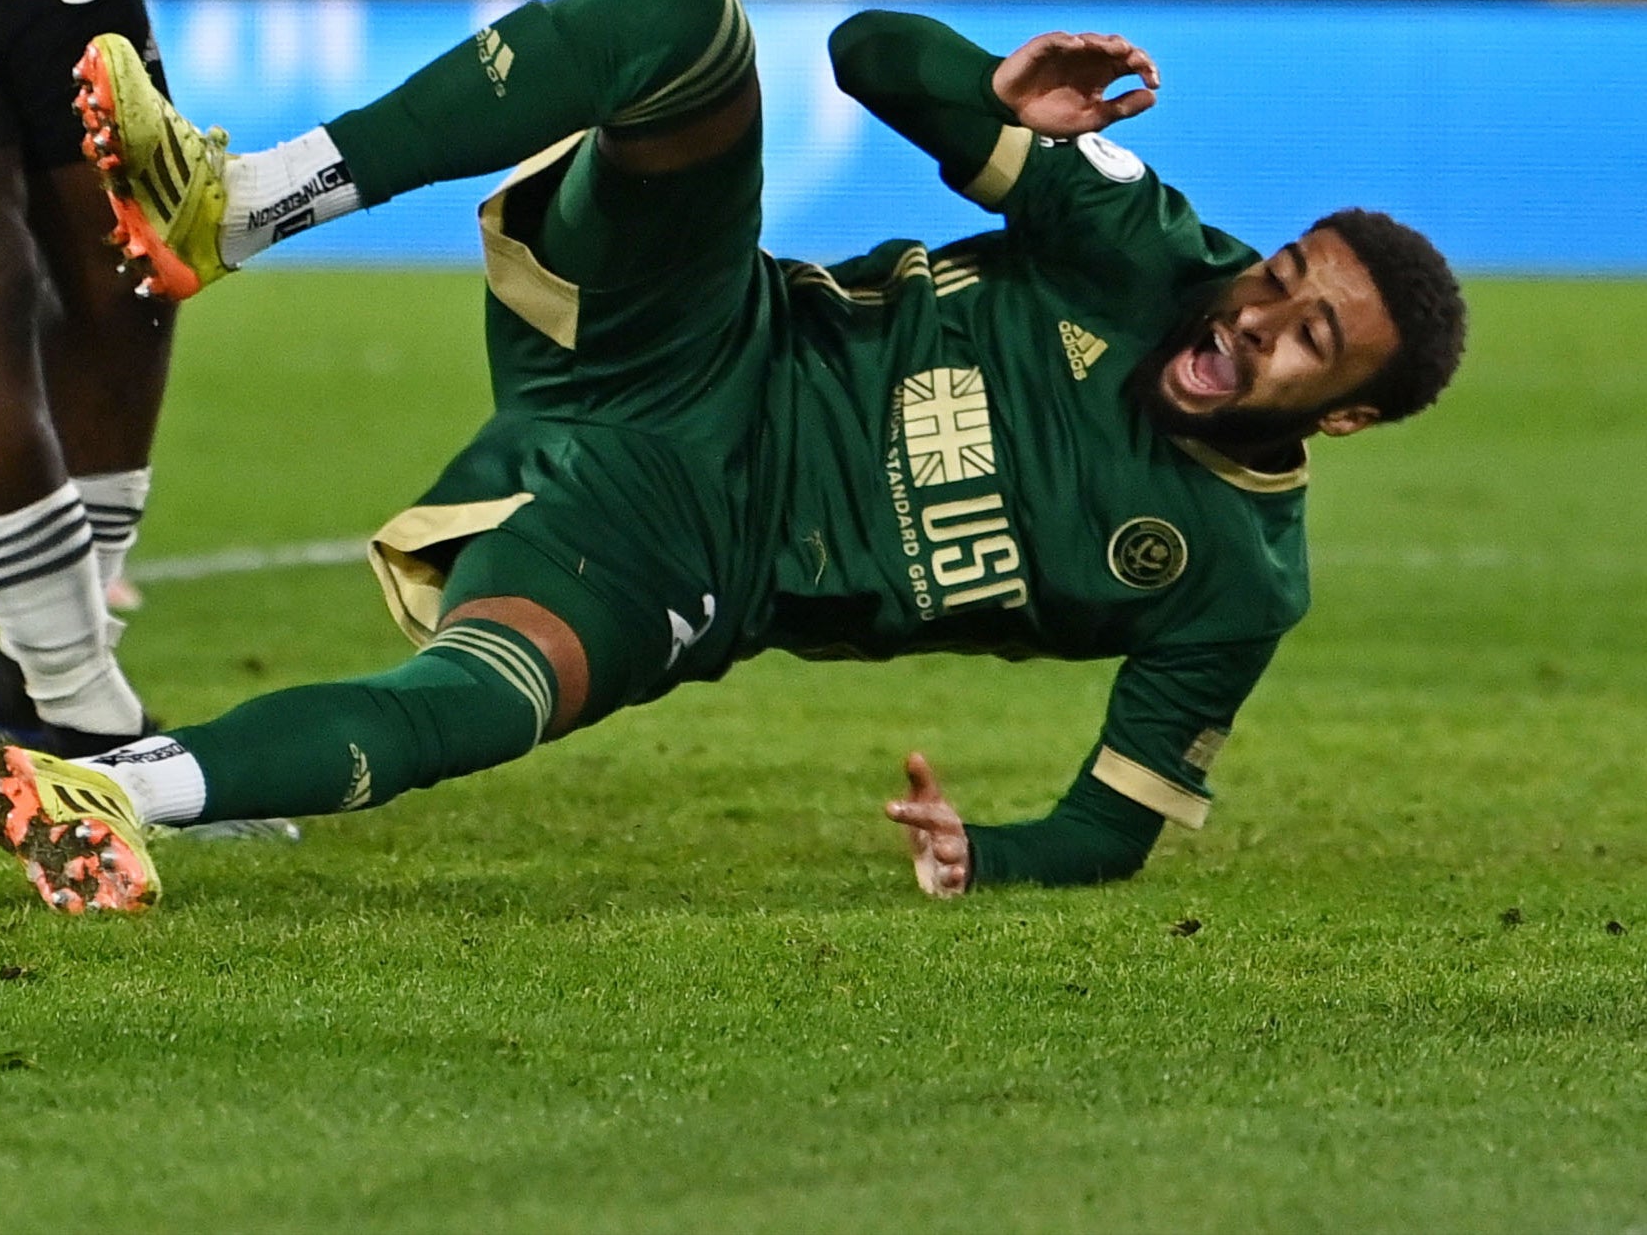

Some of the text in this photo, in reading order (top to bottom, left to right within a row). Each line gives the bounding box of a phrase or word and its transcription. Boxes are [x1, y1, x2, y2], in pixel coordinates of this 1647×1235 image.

[1058, 320, 1088, 381] adidas
[886, 446, 920, 557] STANDARD
[908, 563, 937, 621] GROU
